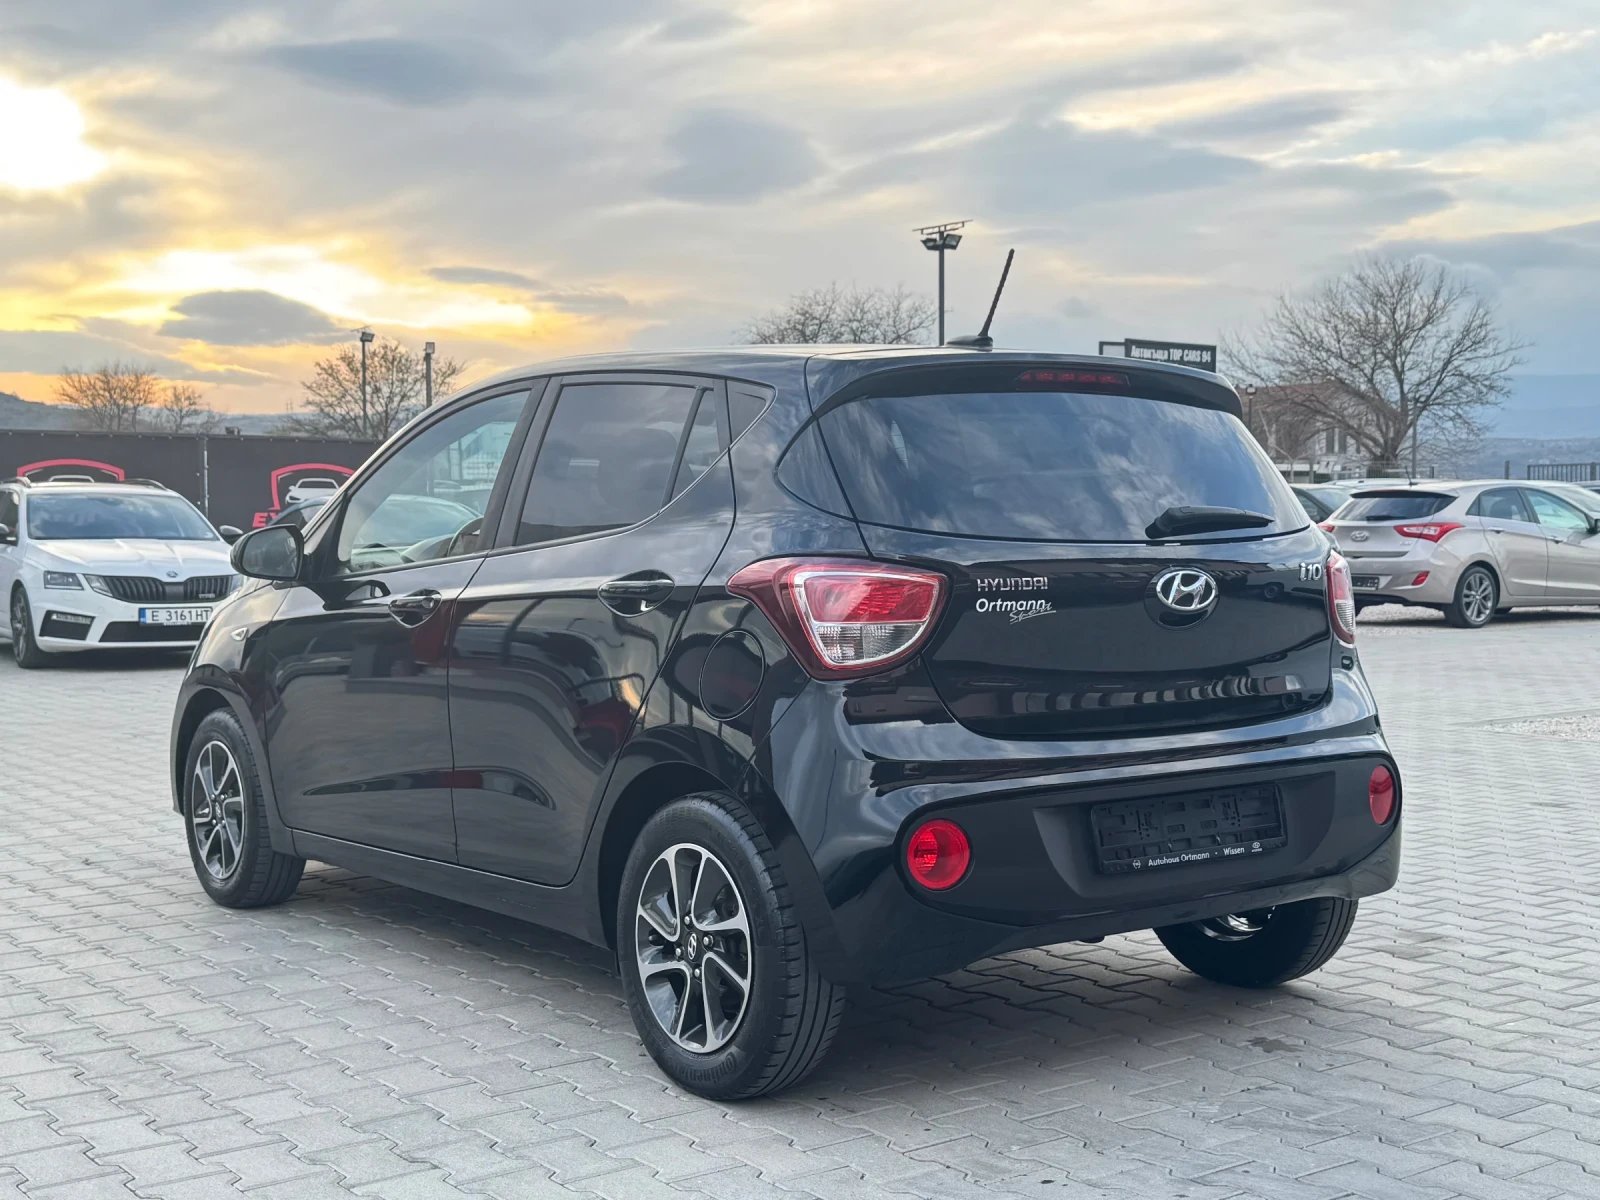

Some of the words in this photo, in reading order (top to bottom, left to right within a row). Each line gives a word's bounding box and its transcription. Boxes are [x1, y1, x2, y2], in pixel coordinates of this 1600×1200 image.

[1169, 348, 1182, 361] TOP
[1183, 349, 1201, 362] CARS
[1299, 562, 1322, 581] i10
[976, 577, 1048, 592] HYUNDAI
[975, 598, 1046, 612] Ortmann
[151, 610, 160, 621] E
[165, 610, 193, 621] 3161
[1148, 855, 1180, 866] Autohaus
[1180, 852, 1210, 862] Ortmann
[1223, 846, 1245, 856] Wissen
